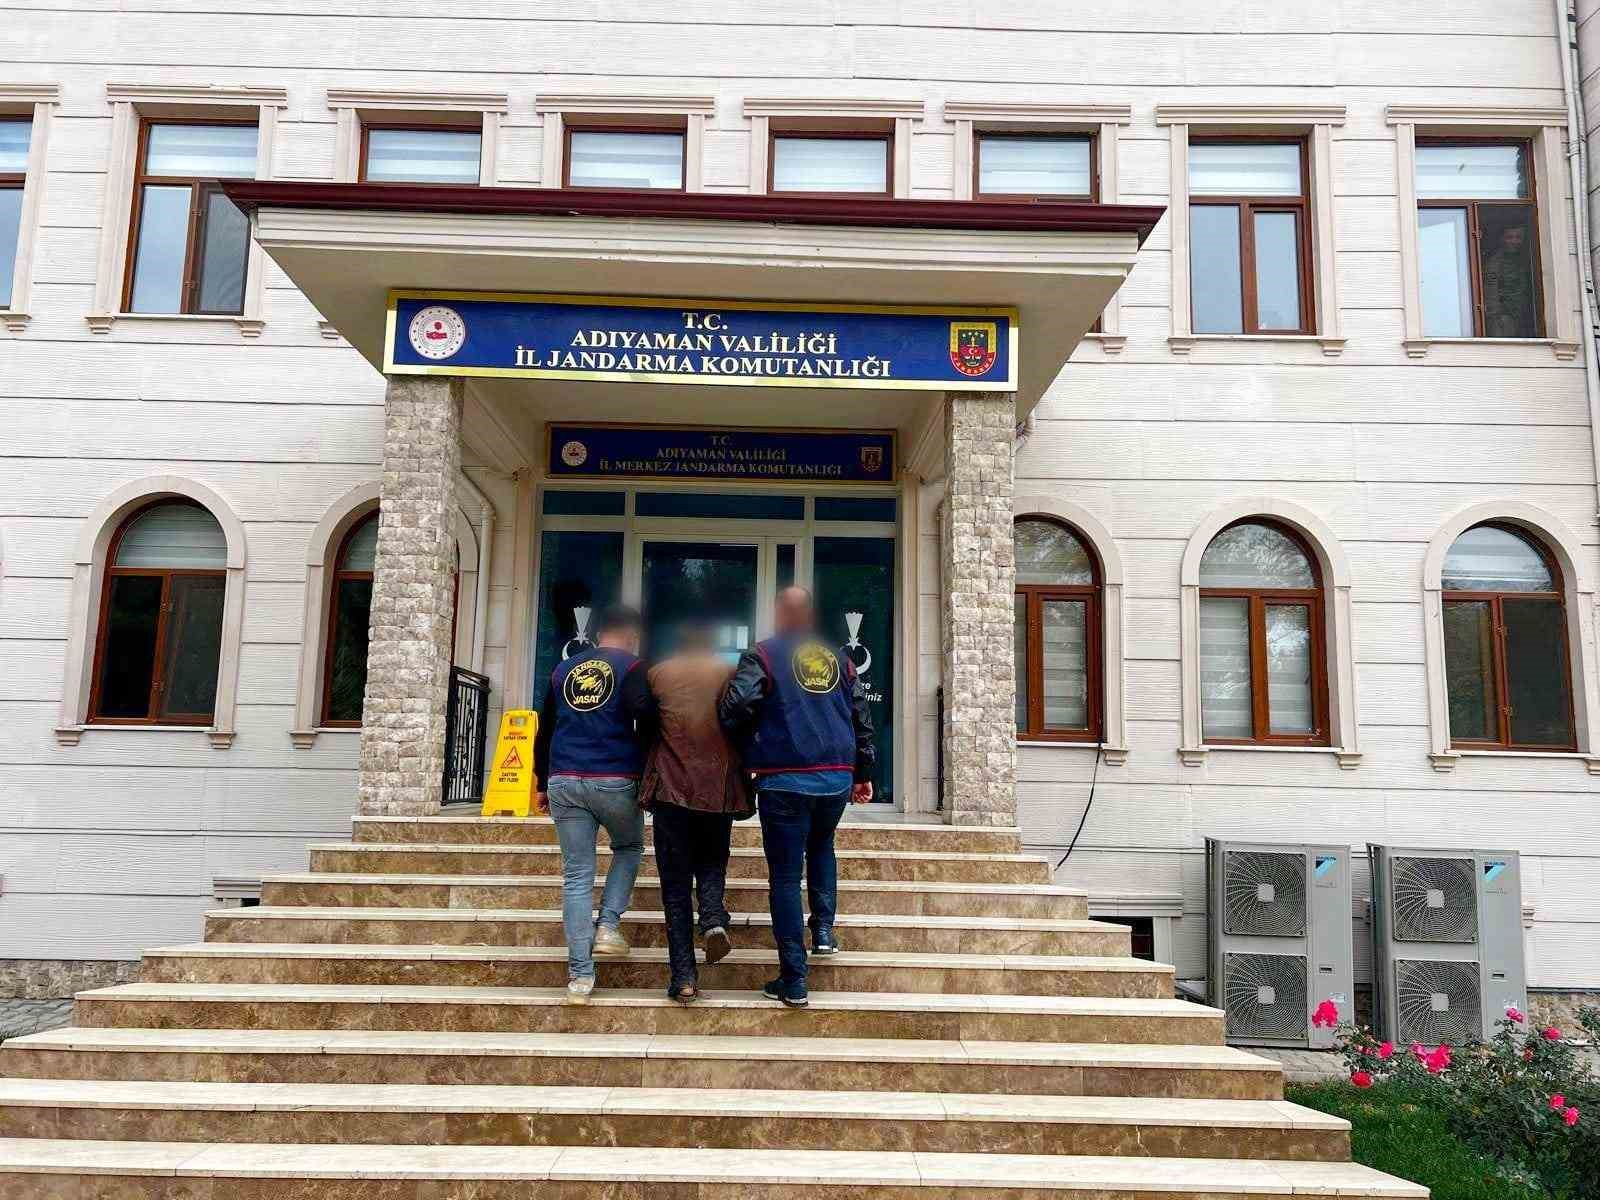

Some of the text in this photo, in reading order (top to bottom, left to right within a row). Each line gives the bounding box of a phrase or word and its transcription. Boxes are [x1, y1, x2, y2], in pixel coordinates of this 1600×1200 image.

[682, 313, 729, 331] T.C.
[570, 330, 837, 355] ADIYAMAN VALİLİĞİ
[514, 345, 891, 377] İL JANDARMA KOMUTANLIĞI
[656, 447, 727, 460] ADIYAMAN
[615, 460, 672, 472] MERKEZ
[676, 461, 747, 474] JANDARMA
[573, 695, 602, 705] JASAT
